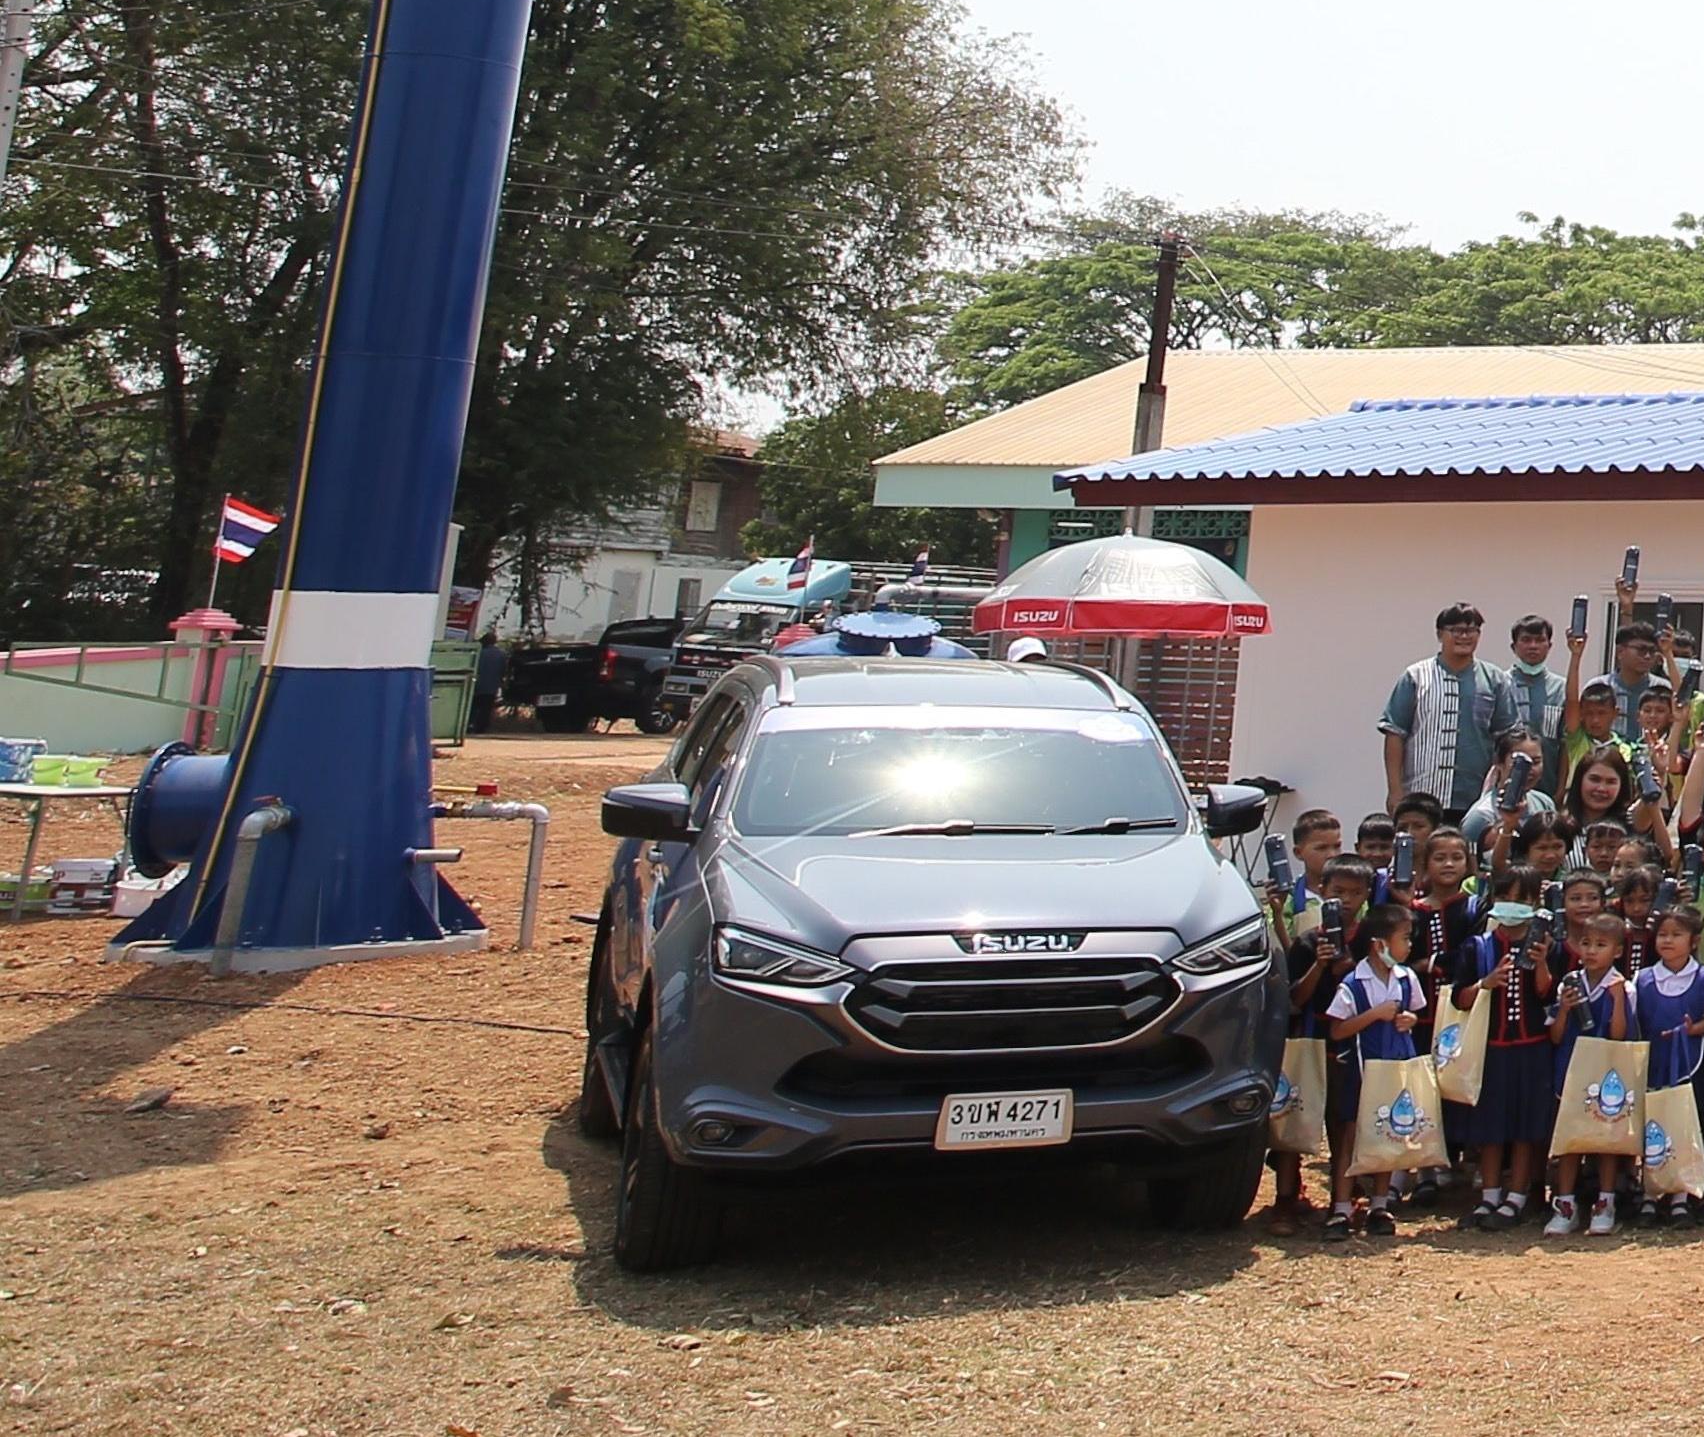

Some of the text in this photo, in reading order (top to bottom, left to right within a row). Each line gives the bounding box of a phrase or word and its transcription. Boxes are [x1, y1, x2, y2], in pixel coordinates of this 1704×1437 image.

[1012, 610, 1060, 623] ISUZU
[1233, 614, 1264, 628] ISUZU
[972, 933, 1069, 953] ISUZU
[1006, 1099, 1062, 1122] 4271
